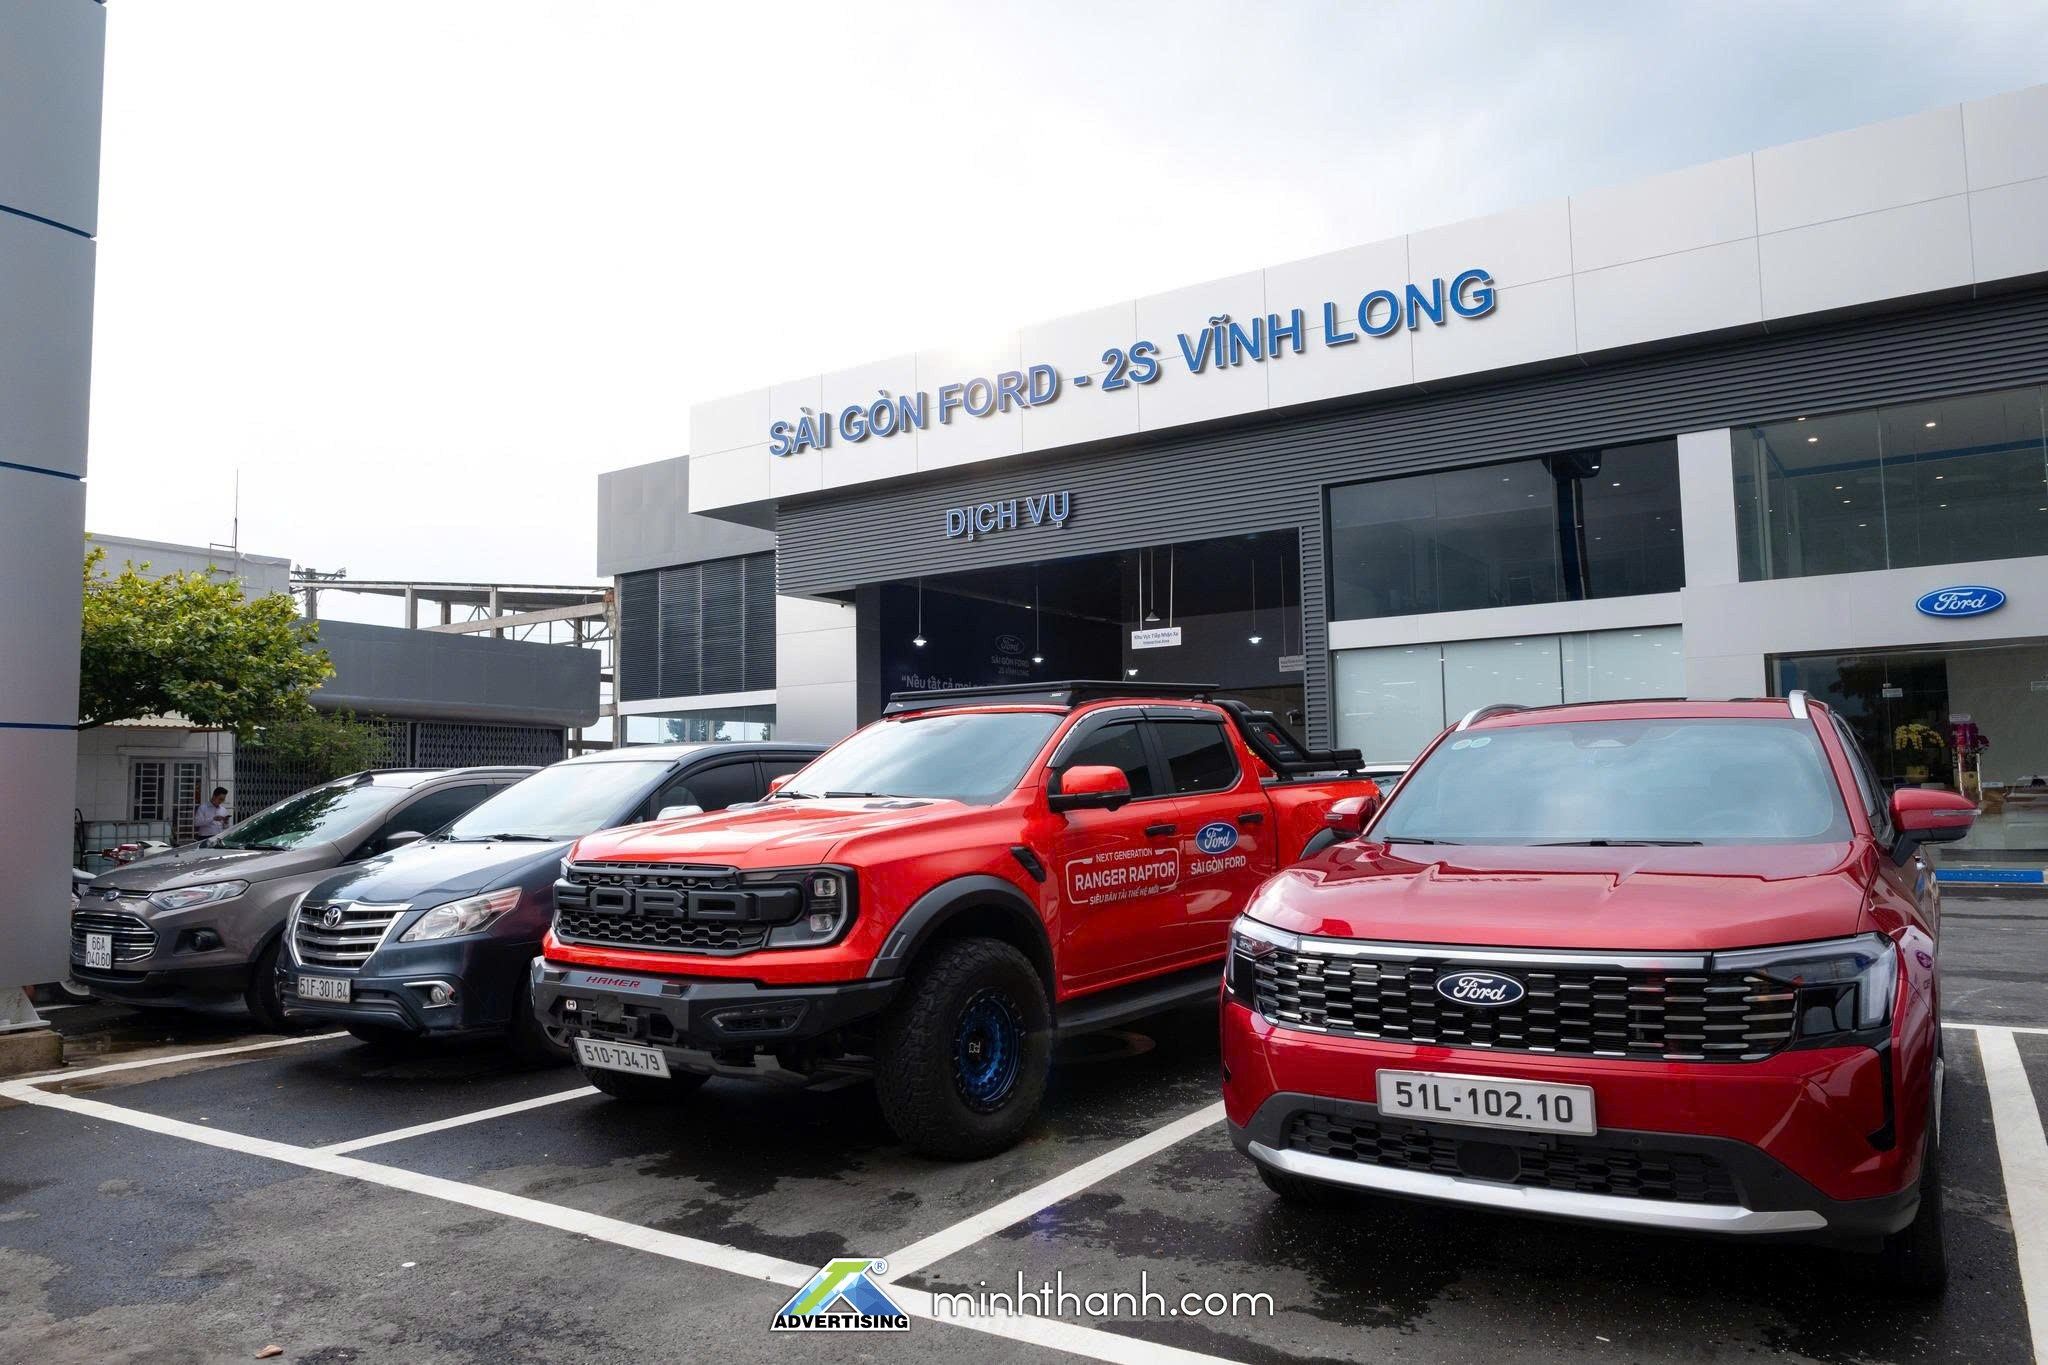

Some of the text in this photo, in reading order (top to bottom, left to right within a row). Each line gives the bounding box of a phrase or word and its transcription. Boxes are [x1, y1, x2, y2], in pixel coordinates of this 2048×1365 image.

[769, 407, 830, 457] SÀI
[839, 390, 928, 442] GÒN
[939, 363, 1058, 425] FORD
[1101, 341, 1158, 391] 2S
[1178, 314, 1304, 373] VĨNH
[1324, 269, 1496, 346] LONG
[946, 491, 1069, 541] DỊCH VỤ
[1933, 591, 1987, 612] Ford
[1204, 827, 1231, 849] Ford
[1096, 847, 1153, 863] NEXT GENERATION
[1191, 855, 1246, 875] SÀI GÒN FORD
[1075, 861, 1176, 891] RANGER RAPTOR
[1089, 894, 1104, 905] SIÊU
[91, 936, 106, 951] 66A
[87, 951, 111, 967] 040.60
[300, 978, 349, 999] 51F-301.84
[586, 975, 641, 989] HAMER
[1453, 976, 1507, 1001] Ford
[583, 1045, 660, 1071] 51D-734.79
[1395, 1080, 1574, 1124] 51L-102.10
